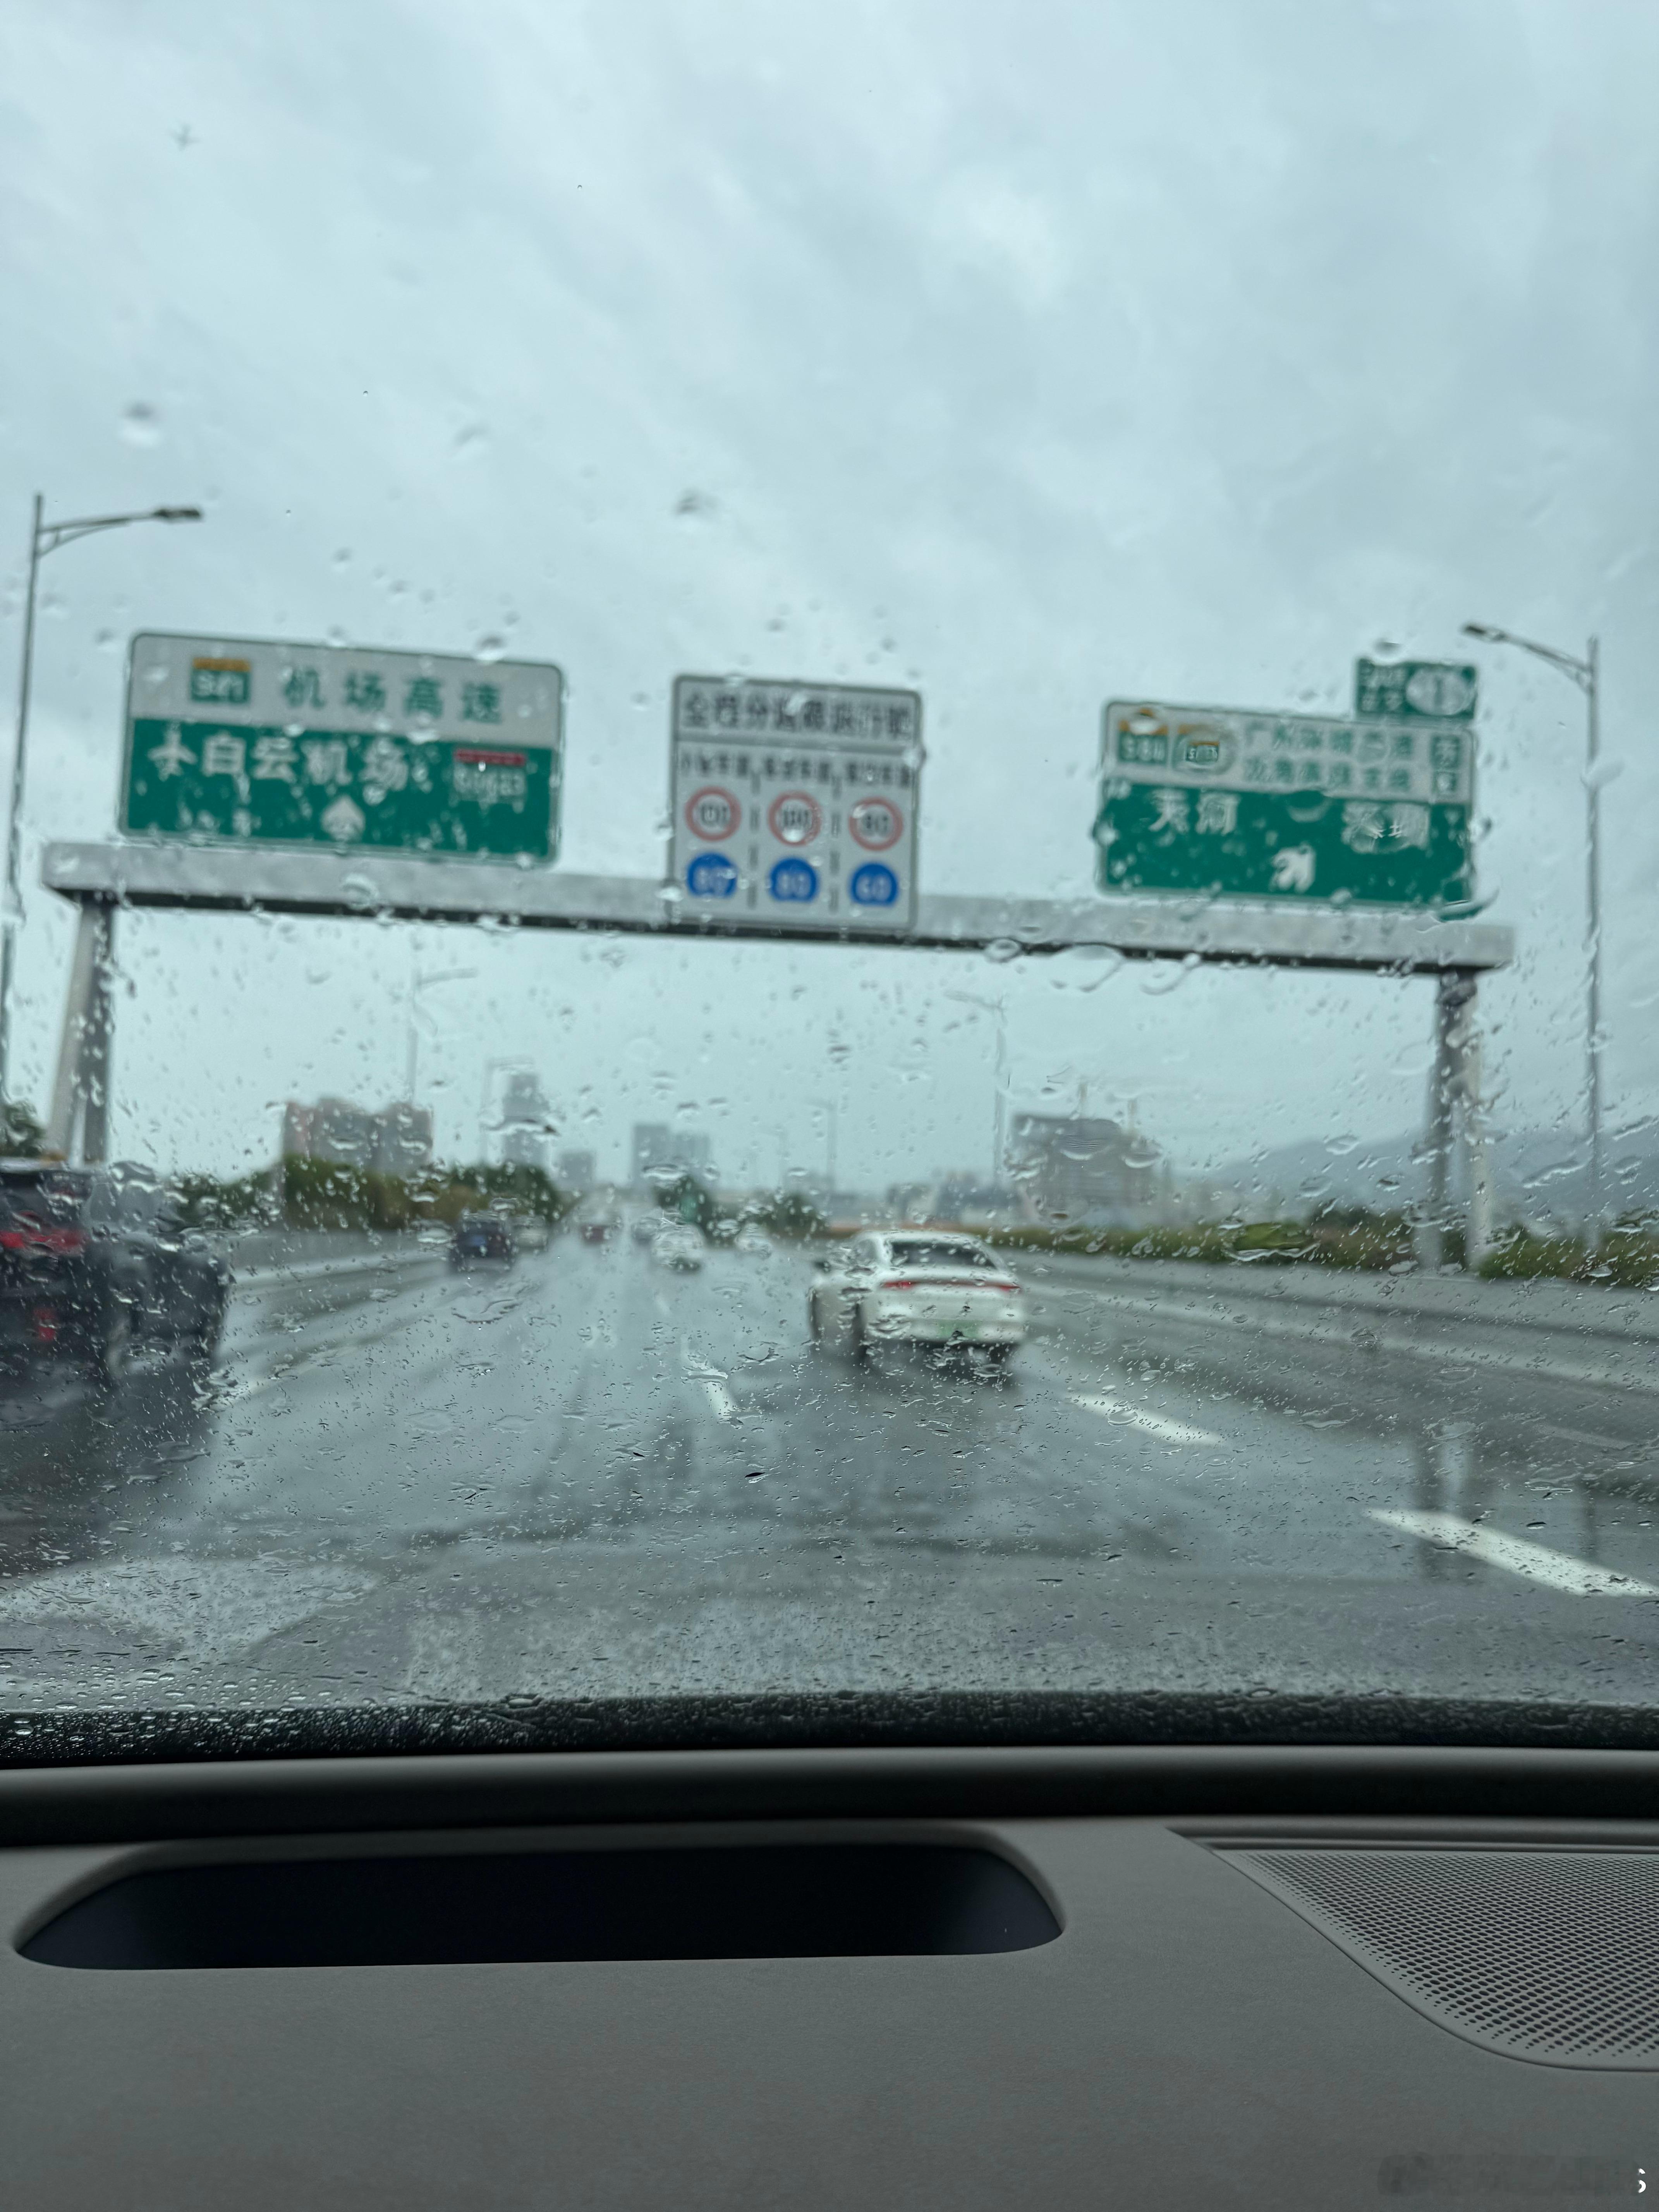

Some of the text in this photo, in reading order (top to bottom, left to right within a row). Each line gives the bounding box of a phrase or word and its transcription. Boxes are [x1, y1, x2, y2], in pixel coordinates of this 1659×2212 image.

[283, 667, 503, 723] 机场高速
[202, 733, 408, 791] 白云机场
[1149, 789, 1240, 836] 天河
